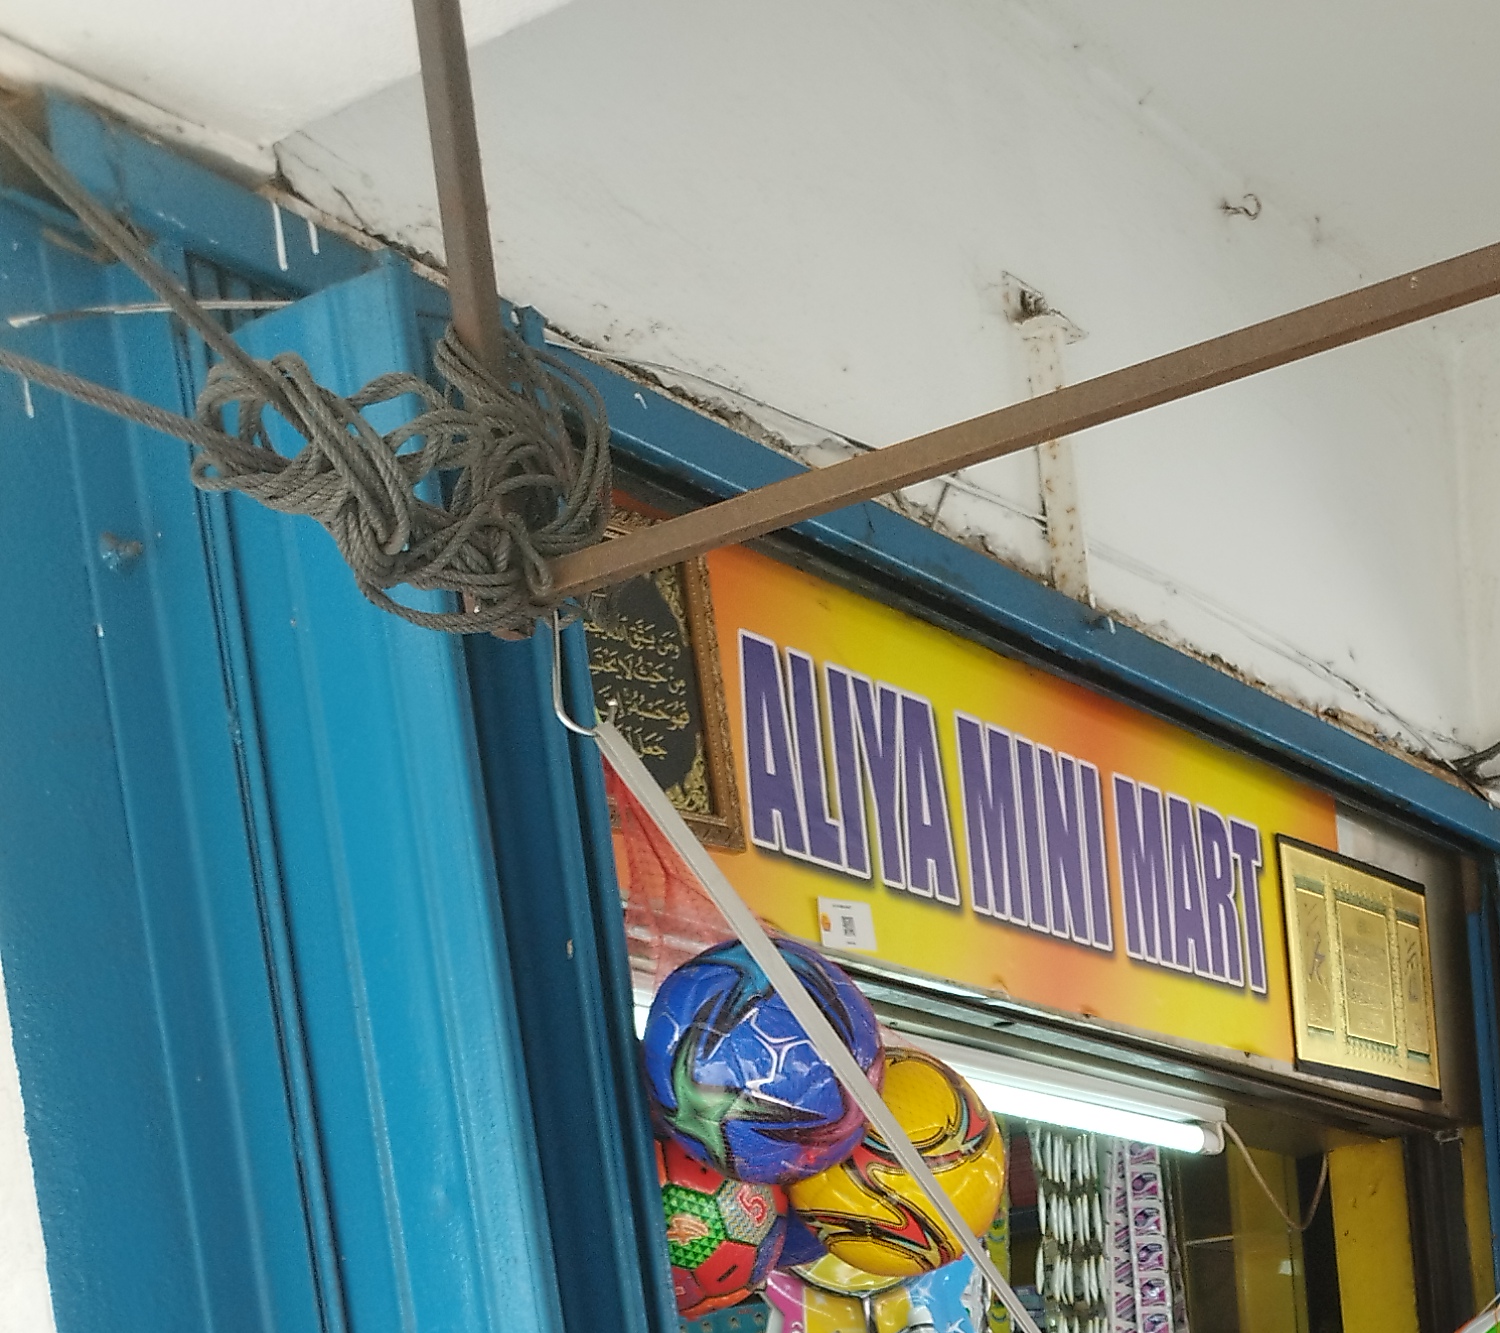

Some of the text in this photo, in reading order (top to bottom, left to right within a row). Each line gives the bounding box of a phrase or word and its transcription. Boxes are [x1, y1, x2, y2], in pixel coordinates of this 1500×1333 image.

[738, 628, 961, 906] ALIYA
[954, 710, 1114, 952] MINI
[1112, 771, 1267, 995] MART
